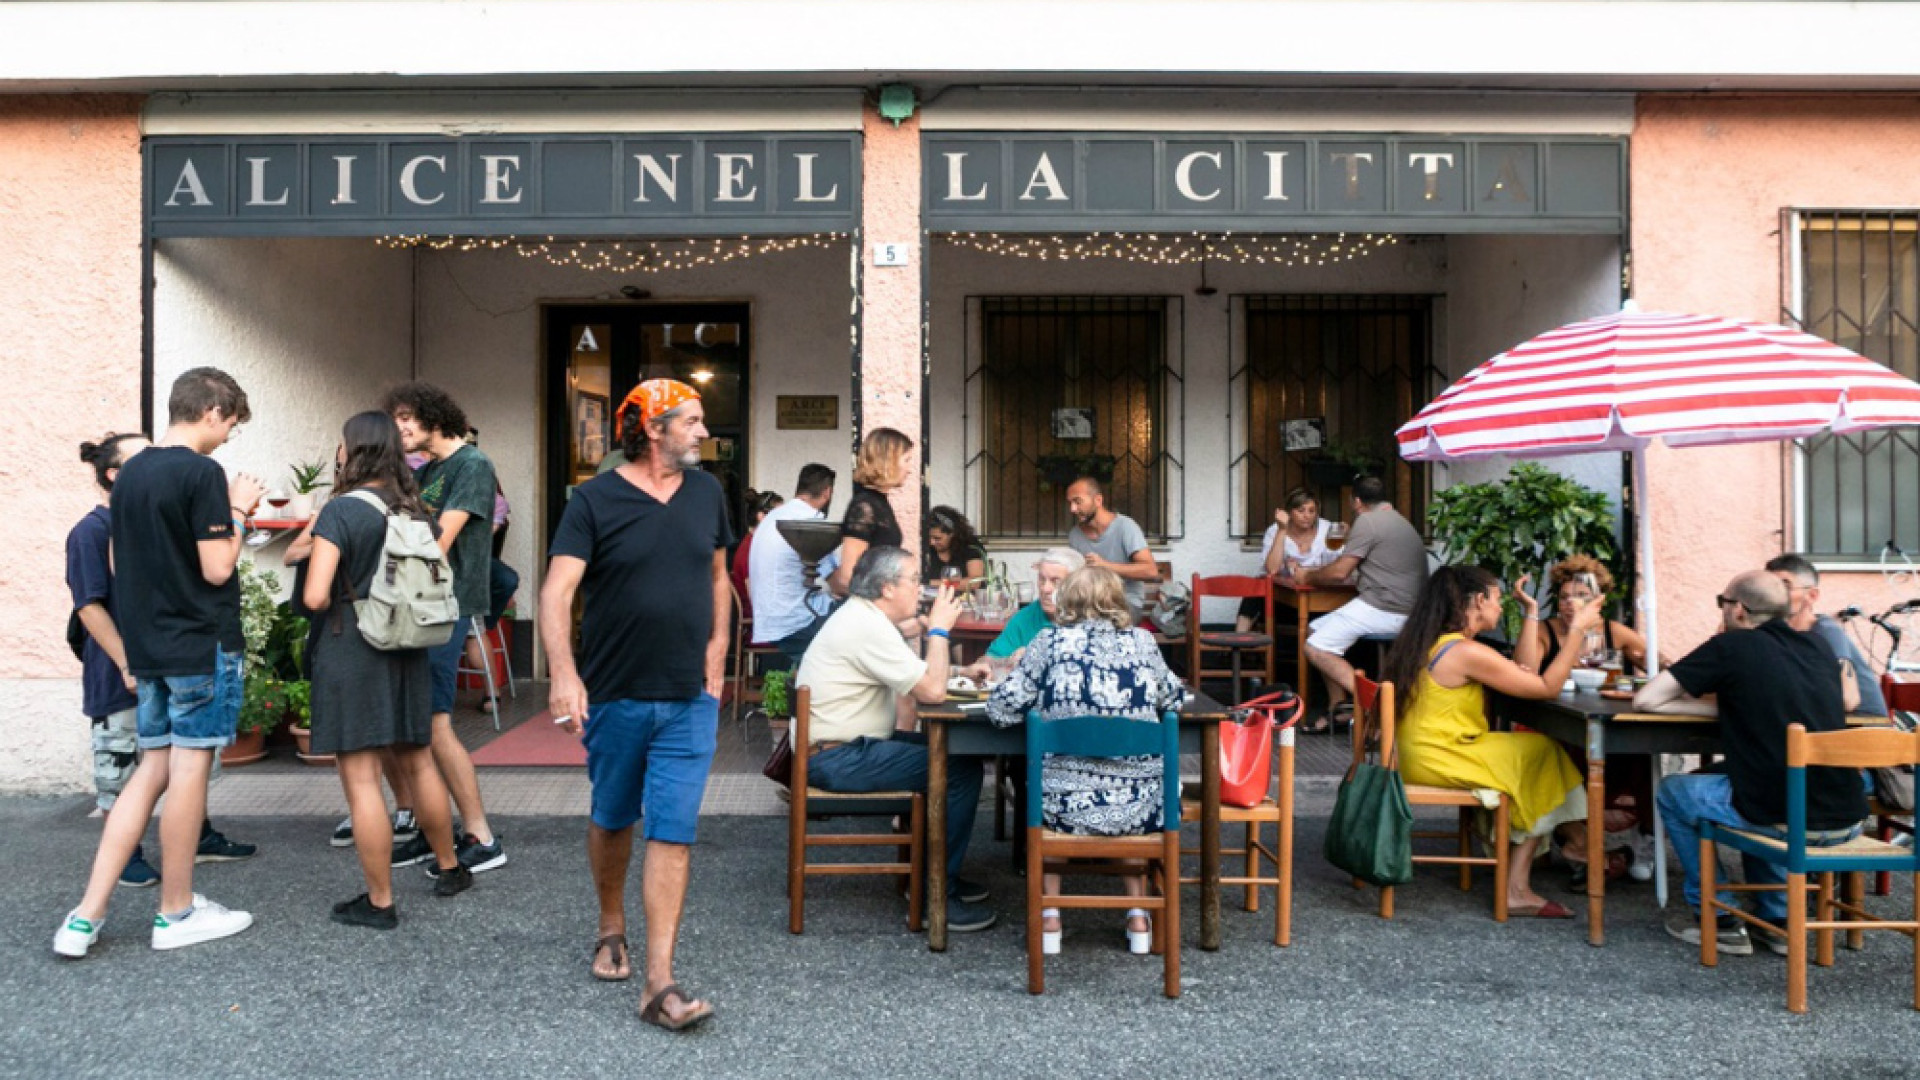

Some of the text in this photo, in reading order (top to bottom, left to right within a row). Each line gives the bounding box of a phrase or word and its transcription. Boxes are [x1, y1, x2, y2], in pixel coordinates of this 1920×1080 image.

[164, 155, 523, 206] ALICE
[633, 153, 837, 202] NEL
[942, 151, 1069, 201] LA
[886, 245, 896, 262] 5
